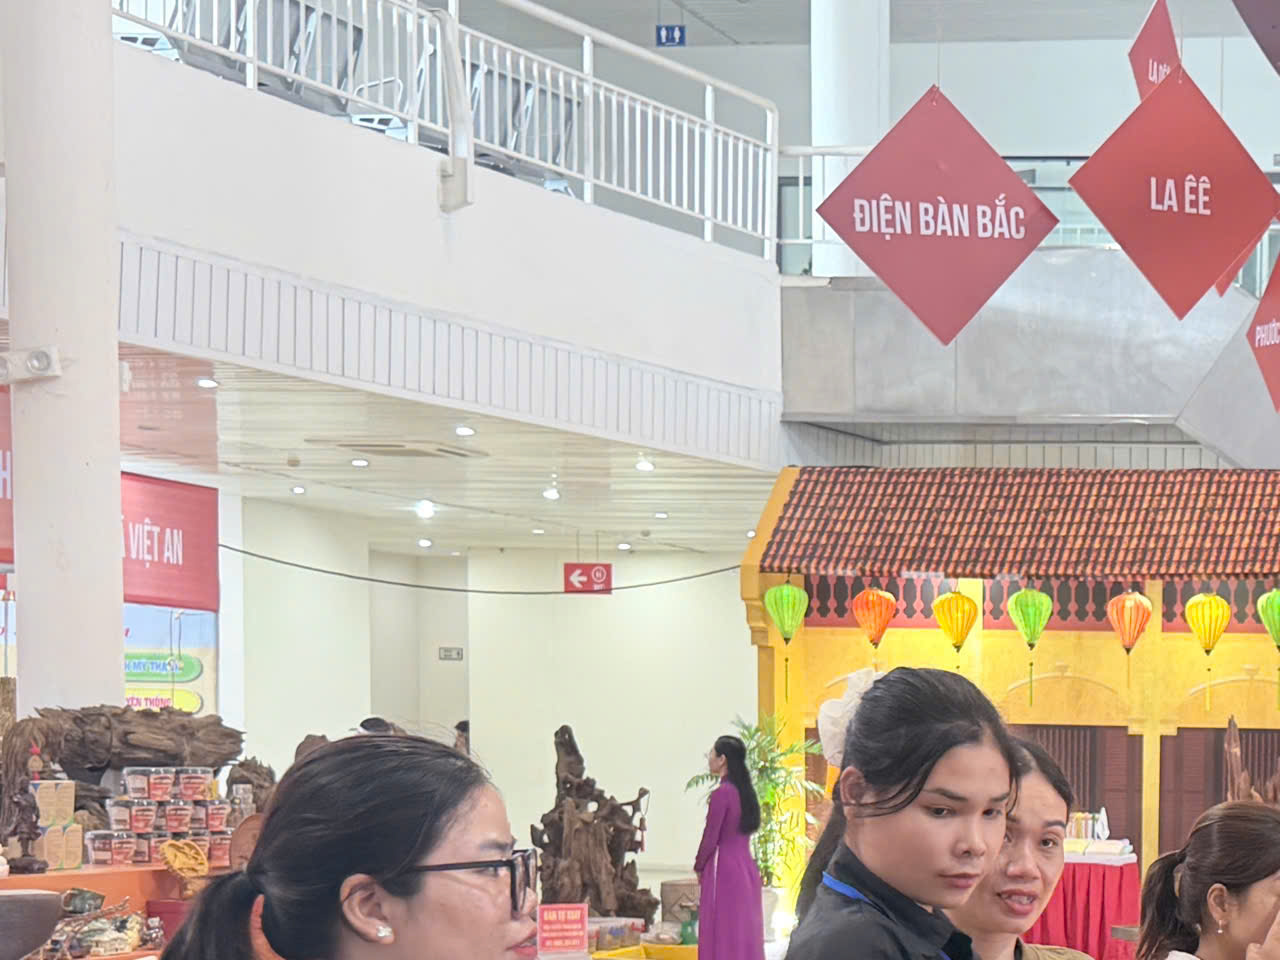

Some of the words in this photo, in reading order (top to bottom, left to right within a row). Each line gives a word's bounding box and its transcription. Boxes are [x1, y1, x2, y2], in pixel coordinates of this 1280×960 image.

[853, 193, 912, 240] ĐIỆN
[918, 196, 970, 237] BÀN
[976, 193, 1026, 239] BẮC
[1150, 176, 1178, 212] LA
[1184, 174, 1212, 215] ÊÊ
[128, 517, 160, 568] VIỆT
[164, 528, 183, 566] AN
